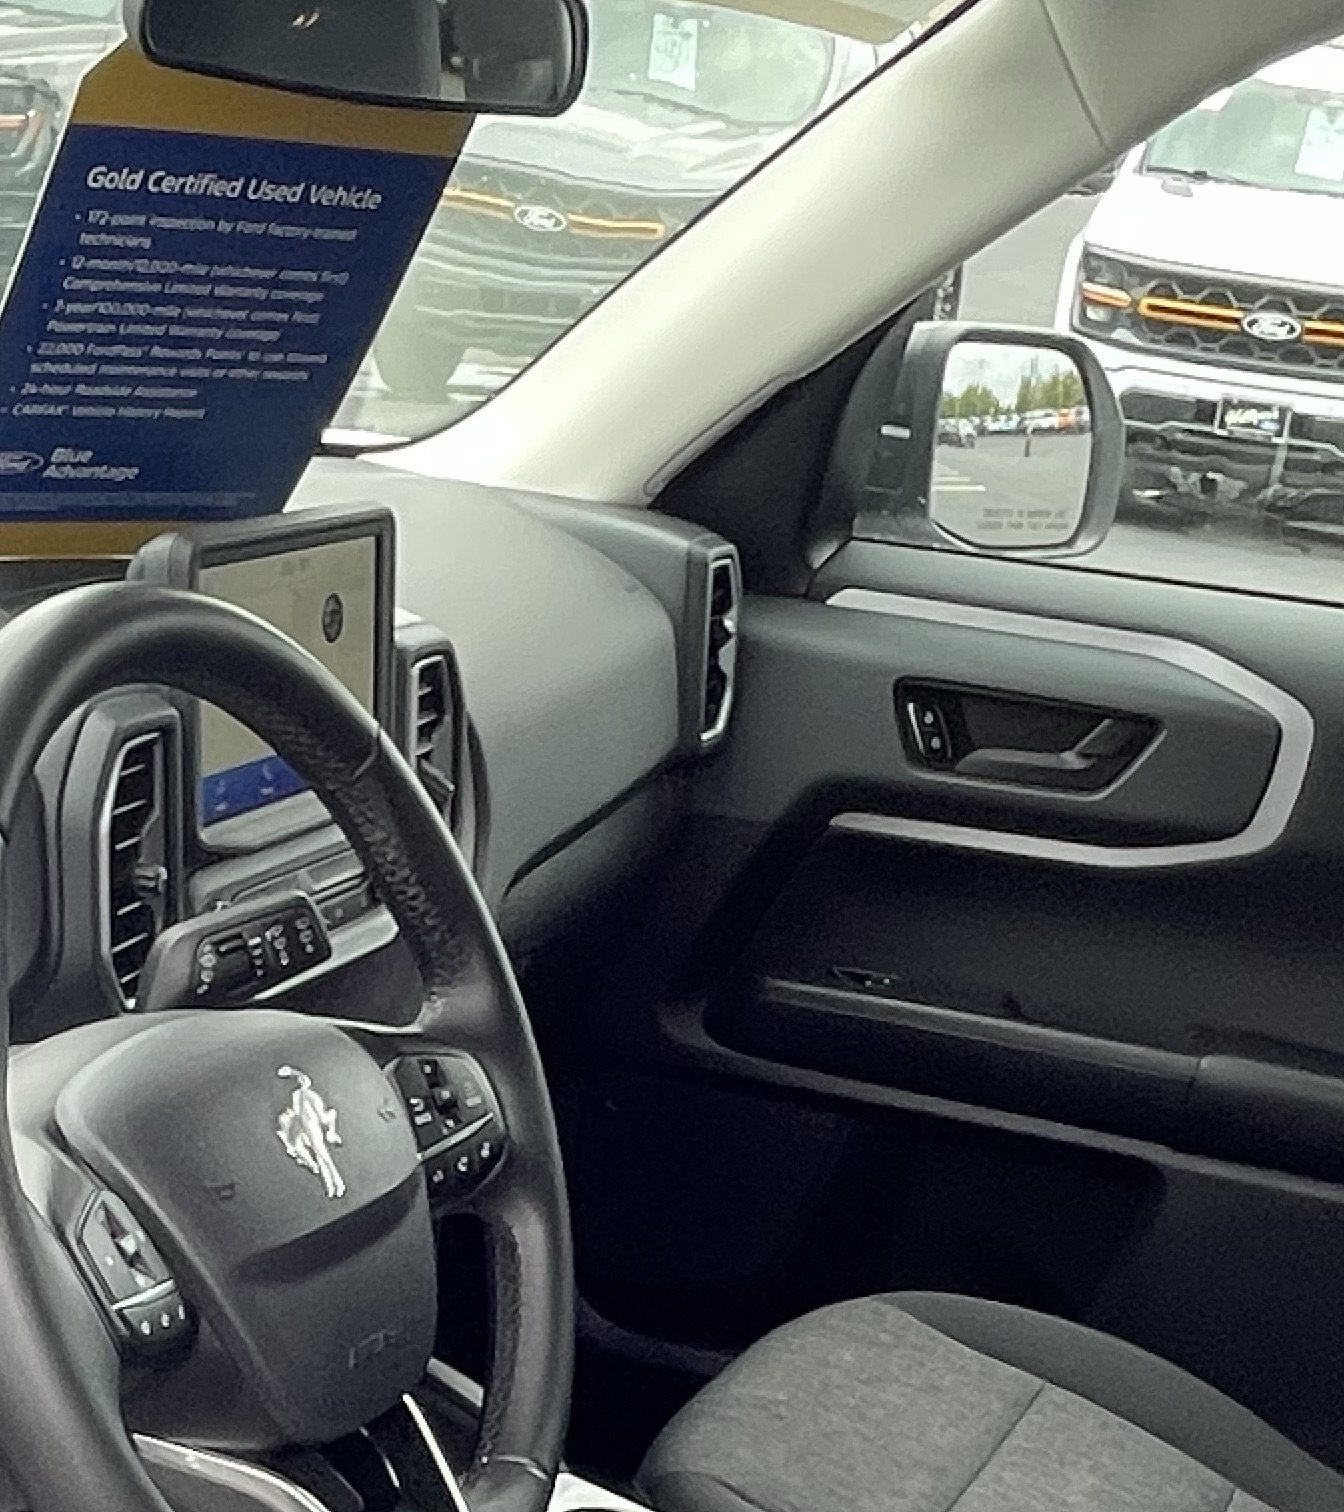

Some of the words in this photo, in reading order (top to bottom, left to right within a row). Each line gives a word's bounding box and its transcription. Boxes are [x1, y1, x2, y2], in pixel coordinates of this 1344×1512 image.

[86, 165, 145, 190] Gold
[147, 171, 244, 199] Certified
[246, 177, 305, 203] Used
[310, 183, 382, 210] Vehicle
[49, 447, 94, 464] Blue
[42, 465, 140, 482] Advantage
